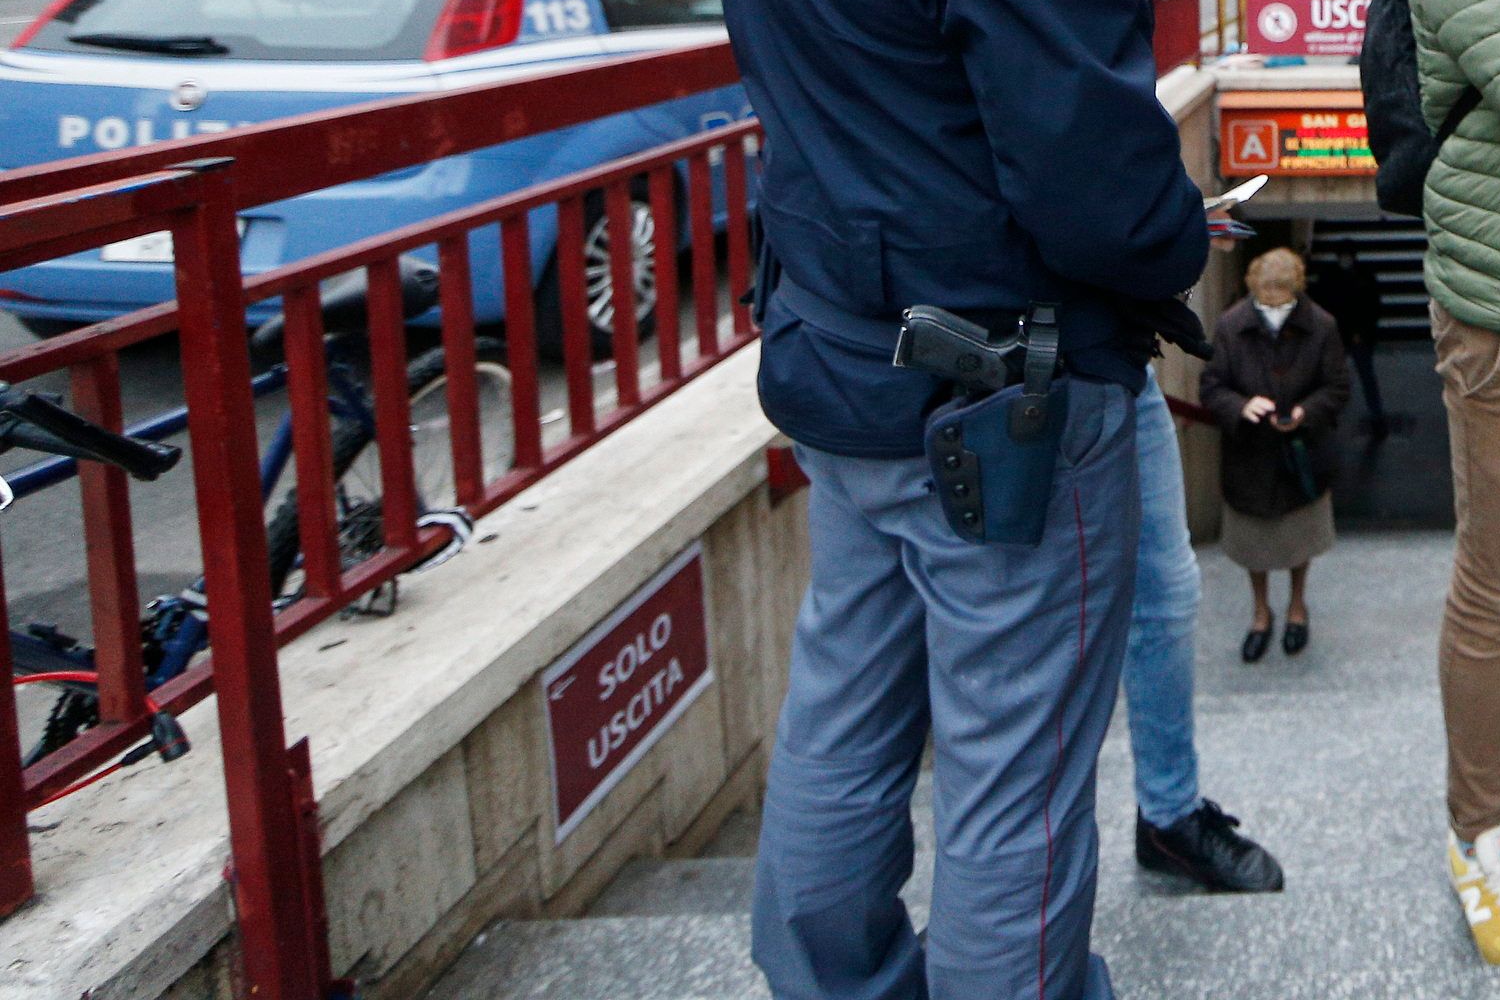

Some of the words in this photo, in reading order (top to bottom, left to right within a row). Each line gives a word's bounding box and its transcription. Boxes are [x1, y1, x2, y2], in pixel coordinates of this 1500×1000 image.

[59, 115, 250, 149] POLI
[1240, 133, 1267, 160] A
[599, 613, 672, 700] SOLO
[587, 656, 684, 769] USCITA
